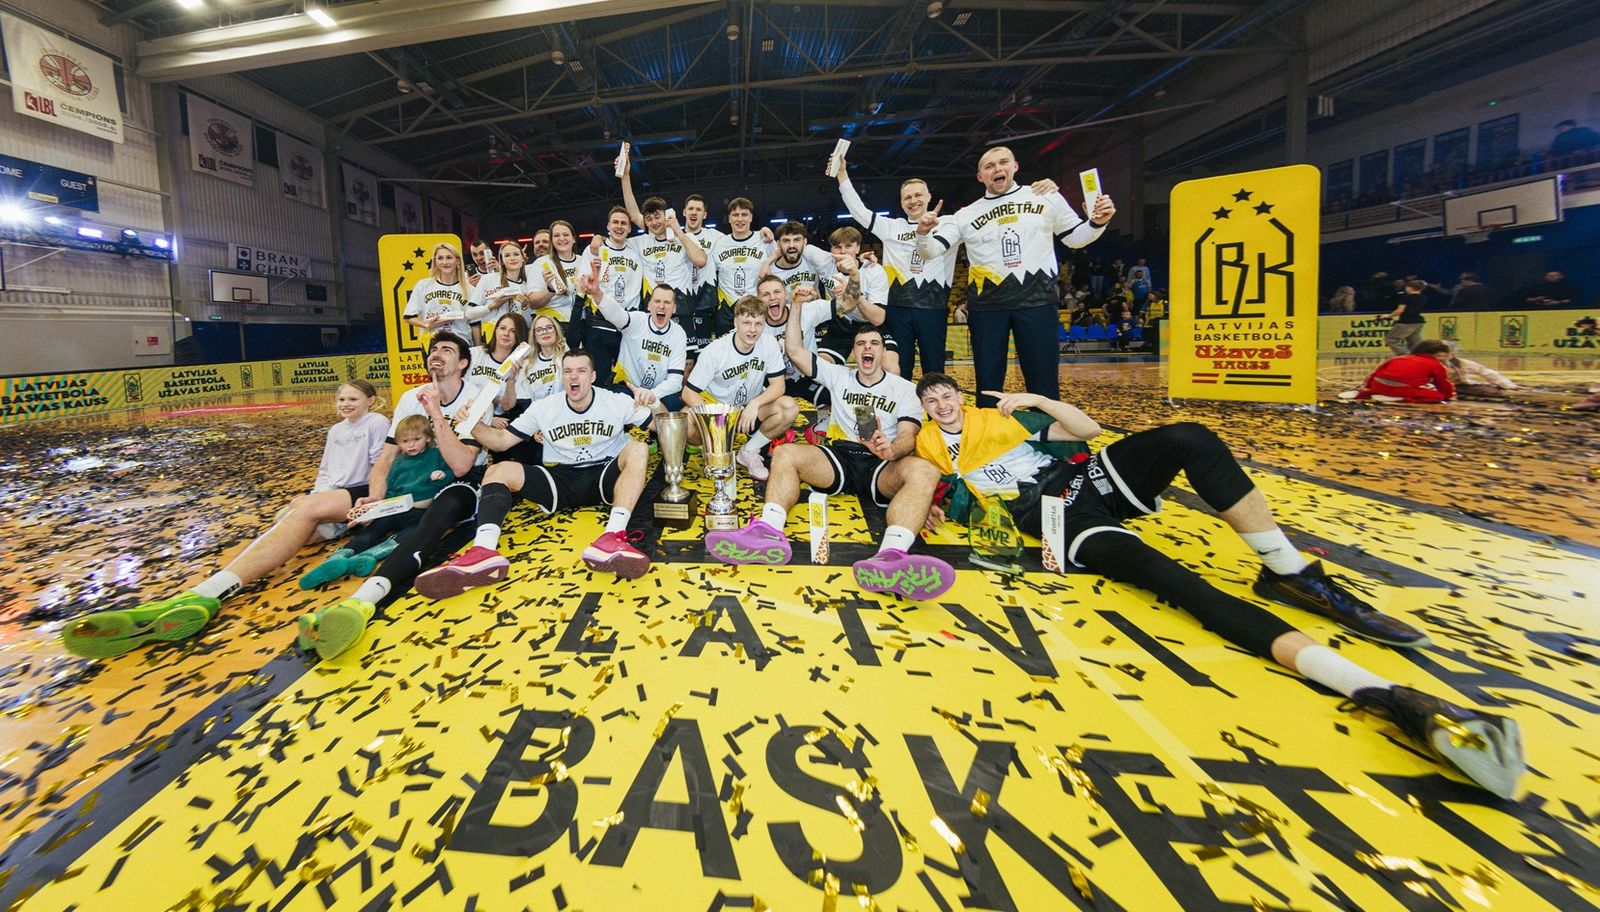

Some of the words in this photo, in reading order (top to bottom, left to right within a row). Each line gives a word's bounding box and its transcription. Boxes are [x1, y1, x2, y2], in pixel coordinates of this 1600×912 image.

[0, 165, 23, 178] OME
[60, 179, 87, 191] GUEST
[256, 250, 298, 266] BRAN
[1194, 321, 1294, 331] LATVIJAS
[1194, 332, 1293, 342] BASKETBOLA
[298, 361, 329, 369] LATVIJAS
[172, 368, 218, 379] LATVIJAS
[294, 368, 335, 376] BASKETBOLA
[164, 376, 225, 388] BASKETBOLA
[318, 375, 339, 383] KAUSS
[14, 379, 88, 393] LATVIJAS
[158, 387, 200, 398] UŽAVAS
[202, 383, 231, 393] KAUSS
[2, 387, 100, 405] BASKETBOLA
[64, 396, 109, 410] KAUSS
